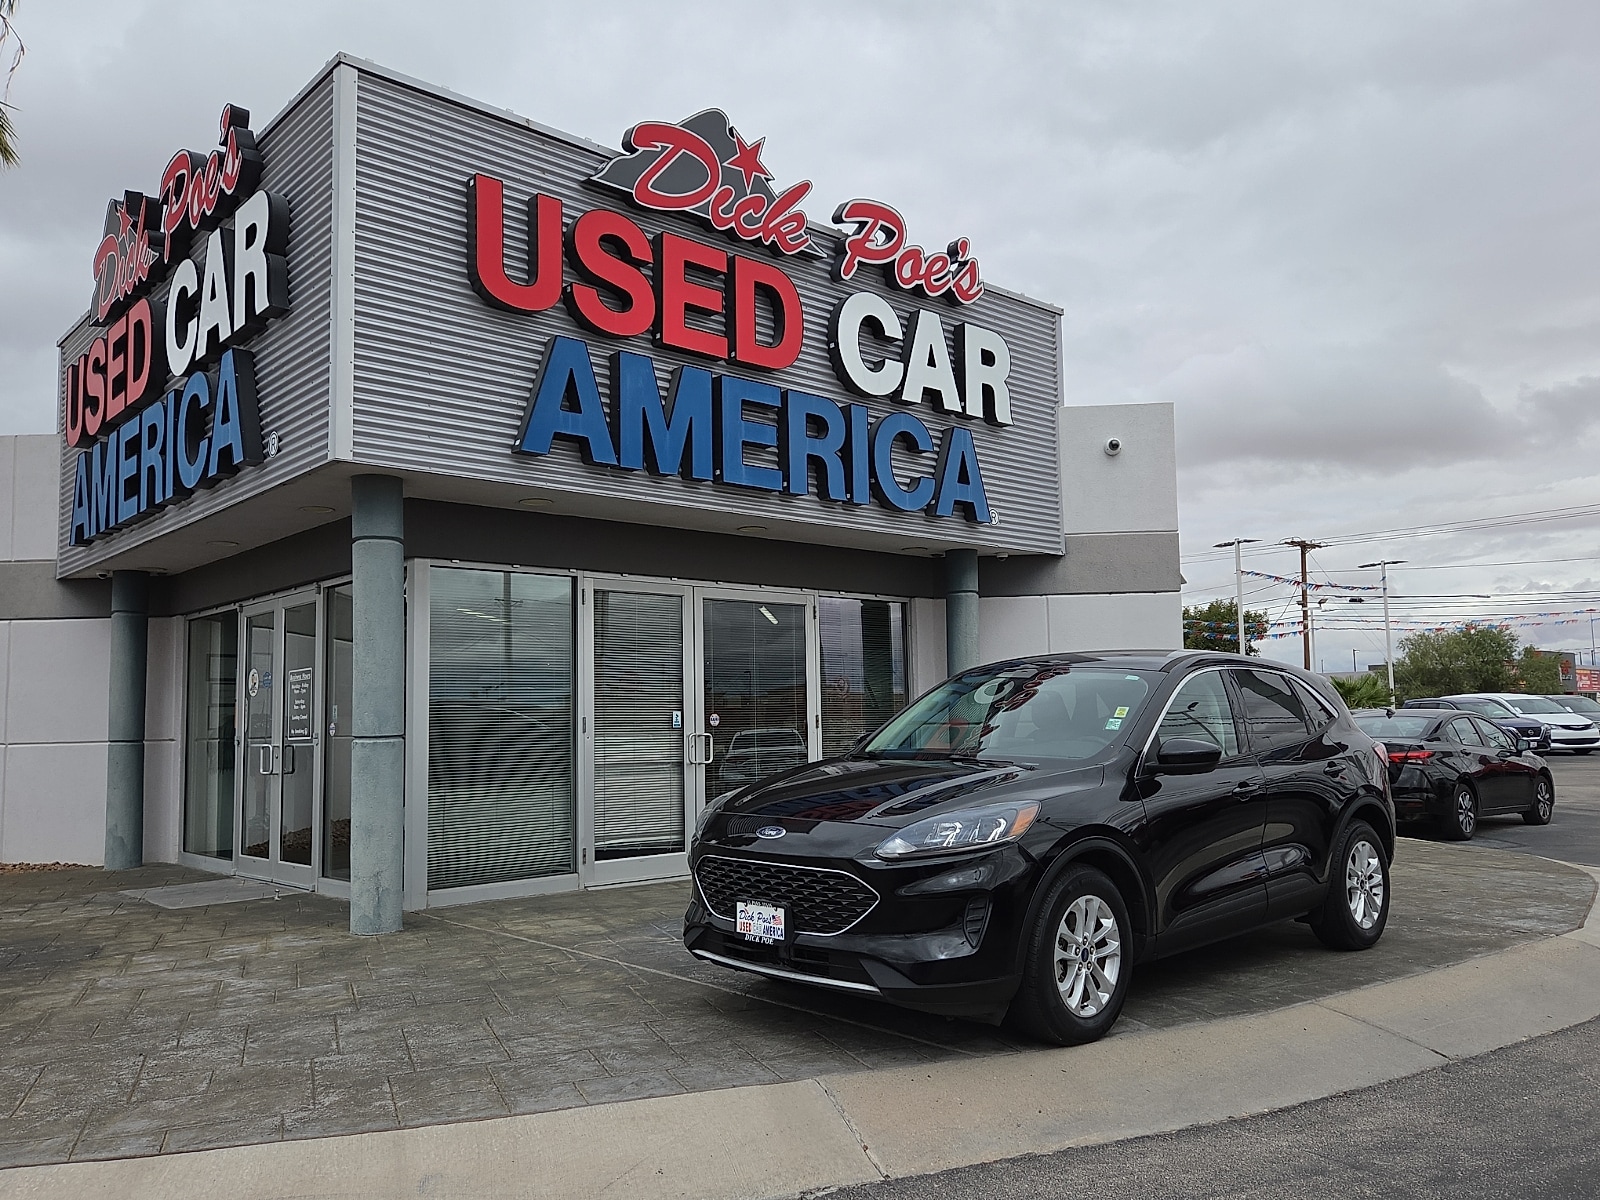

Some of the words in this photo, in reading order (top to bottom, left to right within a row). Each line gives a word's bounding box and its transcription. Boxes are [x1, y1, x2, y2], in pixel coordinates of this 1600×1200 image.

[93, 194, 155, 323] Dick
[160, 103, 242, 264] Poe's
[472, 173, 805, 370] USED
[836, 291, 1014, 427] CAR
[628, 120, 813, 257] Dick
[838, 198, 985, 305] Poe's
[65, 297, 154, 448] USED
[165, 189, 271, 377] CAR
[69, 348, 245, 546] AMERICA
[517, 335, 992, 524] AMERICA
[738, 908, 755, 922] Dick
[739, 921, 752, 933] USED
[762, 924, 784, 939] AMERICA
[744, 933, 760, 943] DICK
[760, 936, 775, 946] POE
